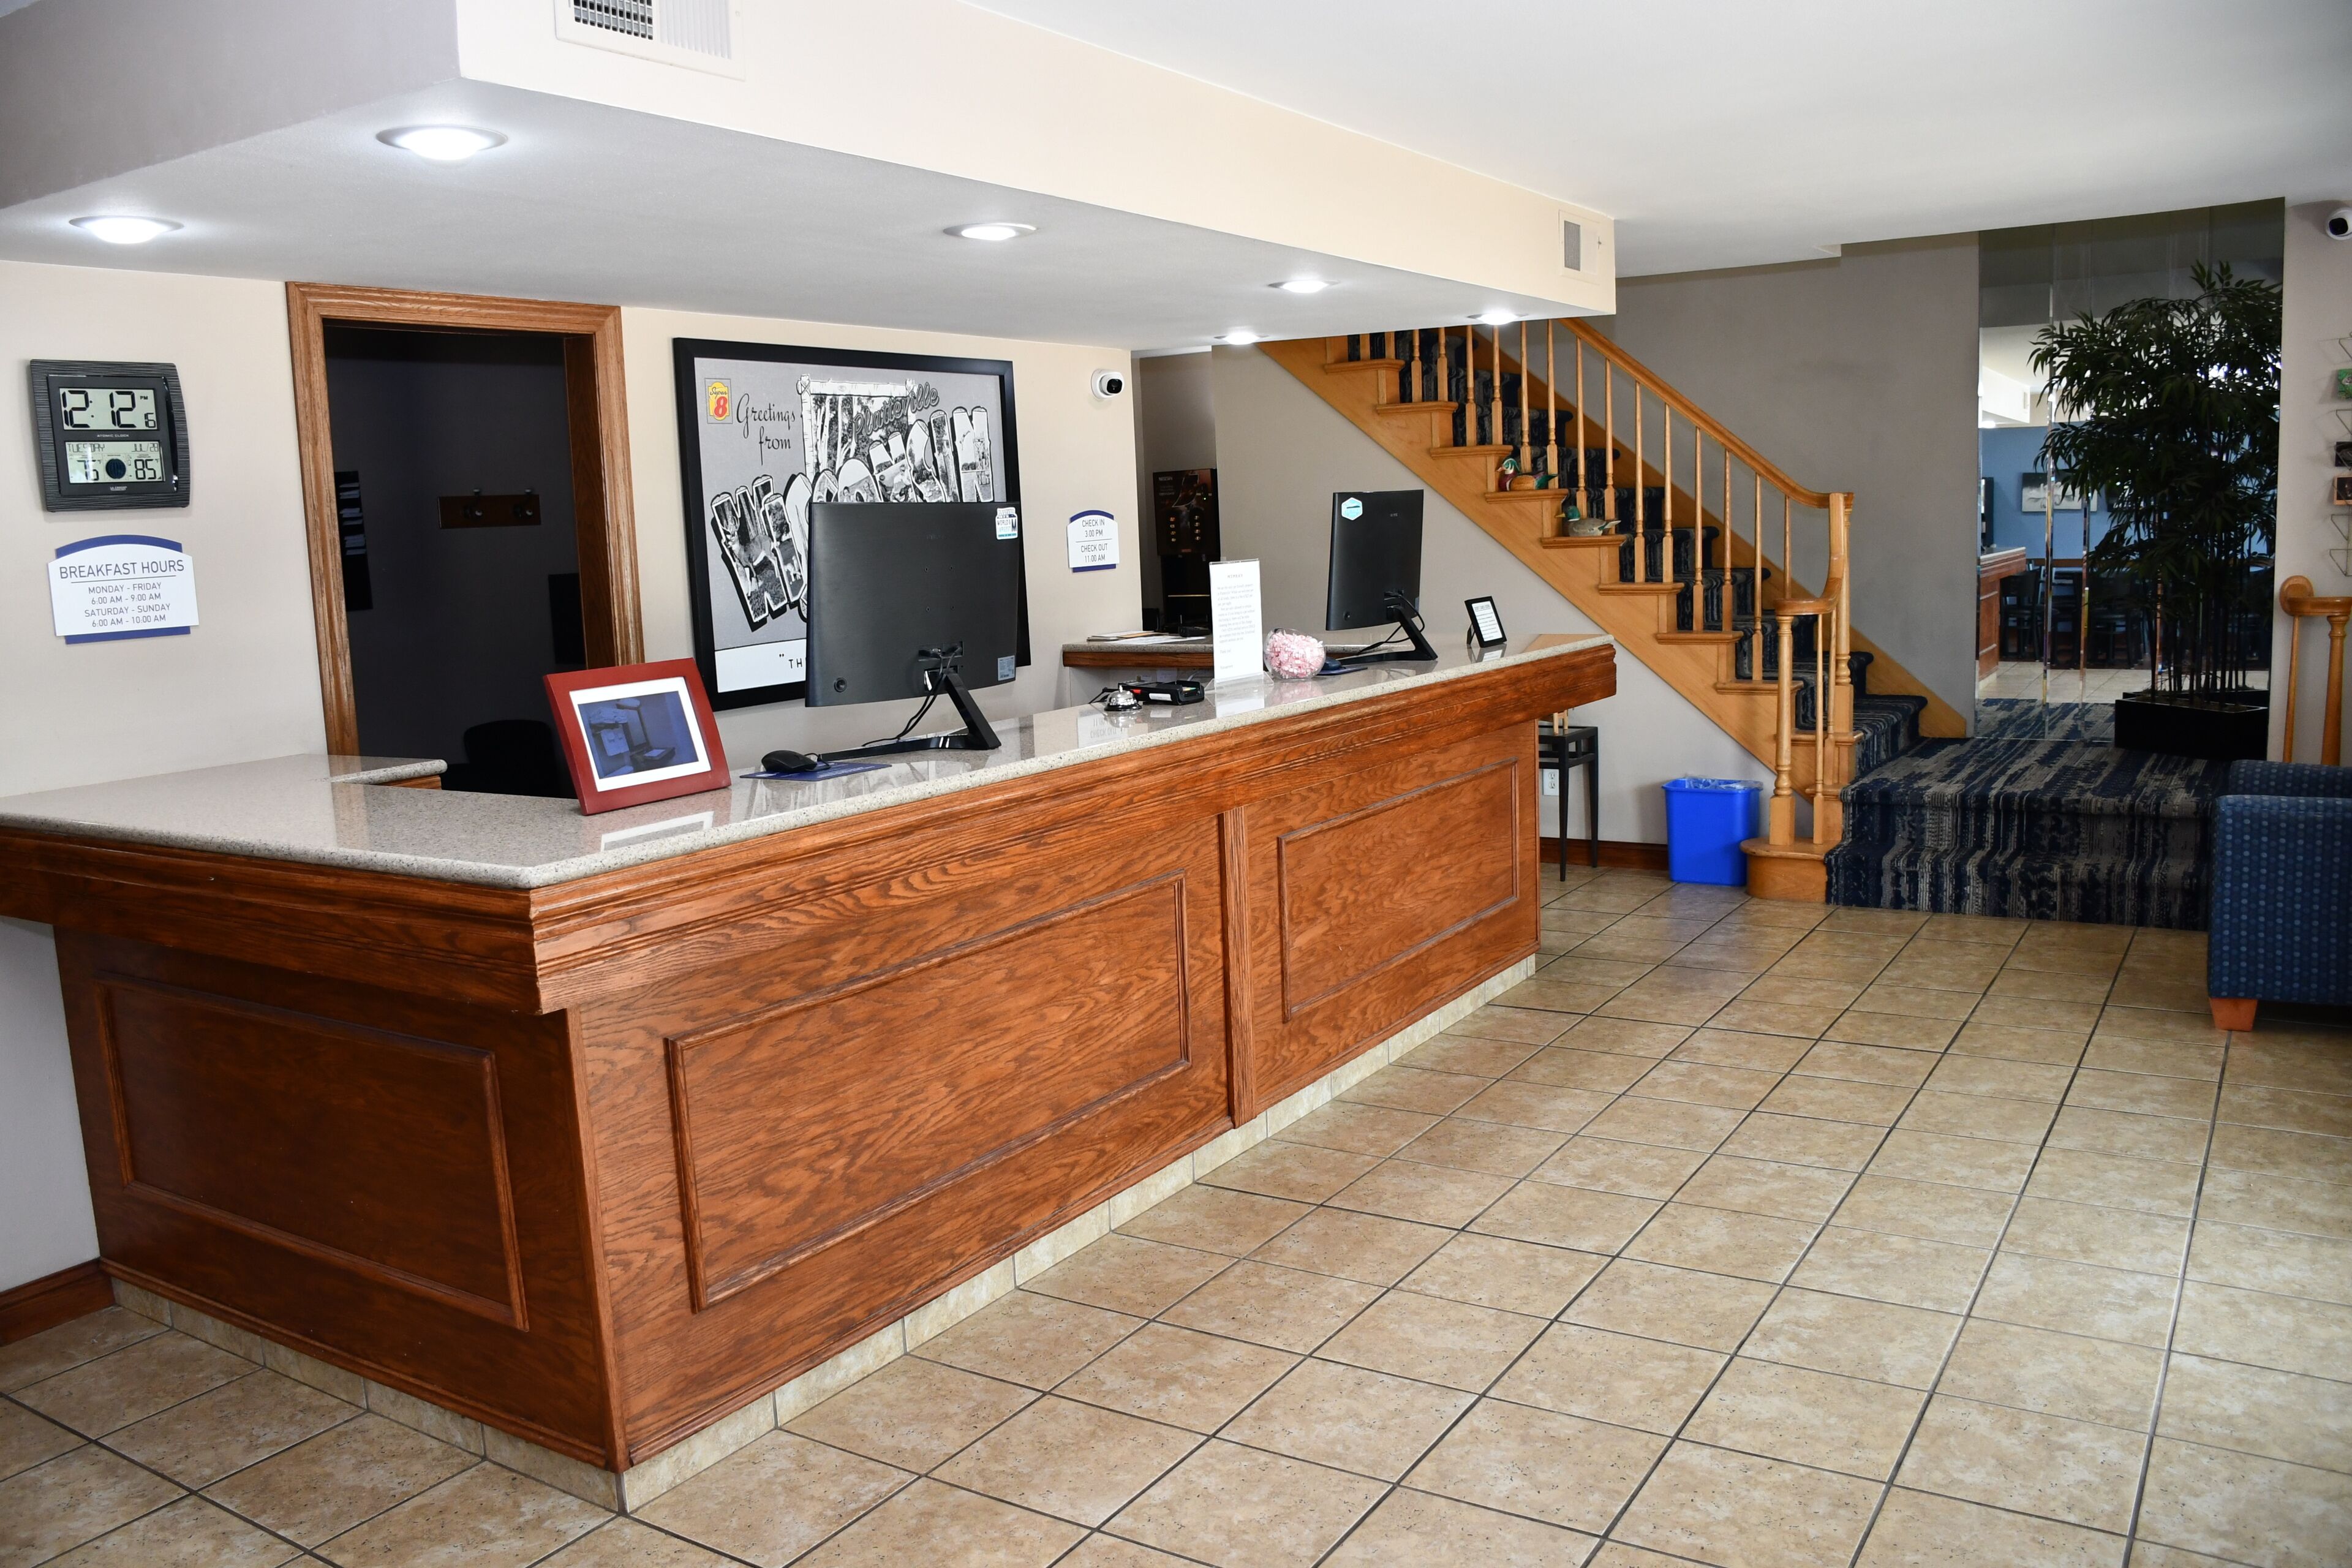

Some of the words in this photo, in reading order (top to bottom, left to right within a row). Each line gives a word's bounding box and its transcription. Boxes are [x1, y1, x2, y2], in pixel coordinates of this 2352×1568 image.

[710, 386, 728, 399] Super
[62, 390, 137, 428] 12:12
[714, 396, 728, 418] 8
[736, 393, 796, 439] Greetings
[853, 382, 940, 444] Platteville
[759, 426, 791, 466] from
[134, 459, 157, 480] 85
[59, 562, 137, 579] BREAKFAST
[141, 560, 184, 574] HOURS
[88, 584, 124, 595] MONDAY
[132, 582, 162, 591] FRIDAY
[91, 597, 107, 605] 6:00
[110, 595, 123, 604] AM
[130, 594, 146, 602] 9:00
[85, 606, 129, 617] SATURDAY
[137, 603, 170, 613] SUNDAY
[92, 619, 108, 627] 6:00
[110, 617, 123, 626] AM
[132, 616, 151, 624] 10:00
